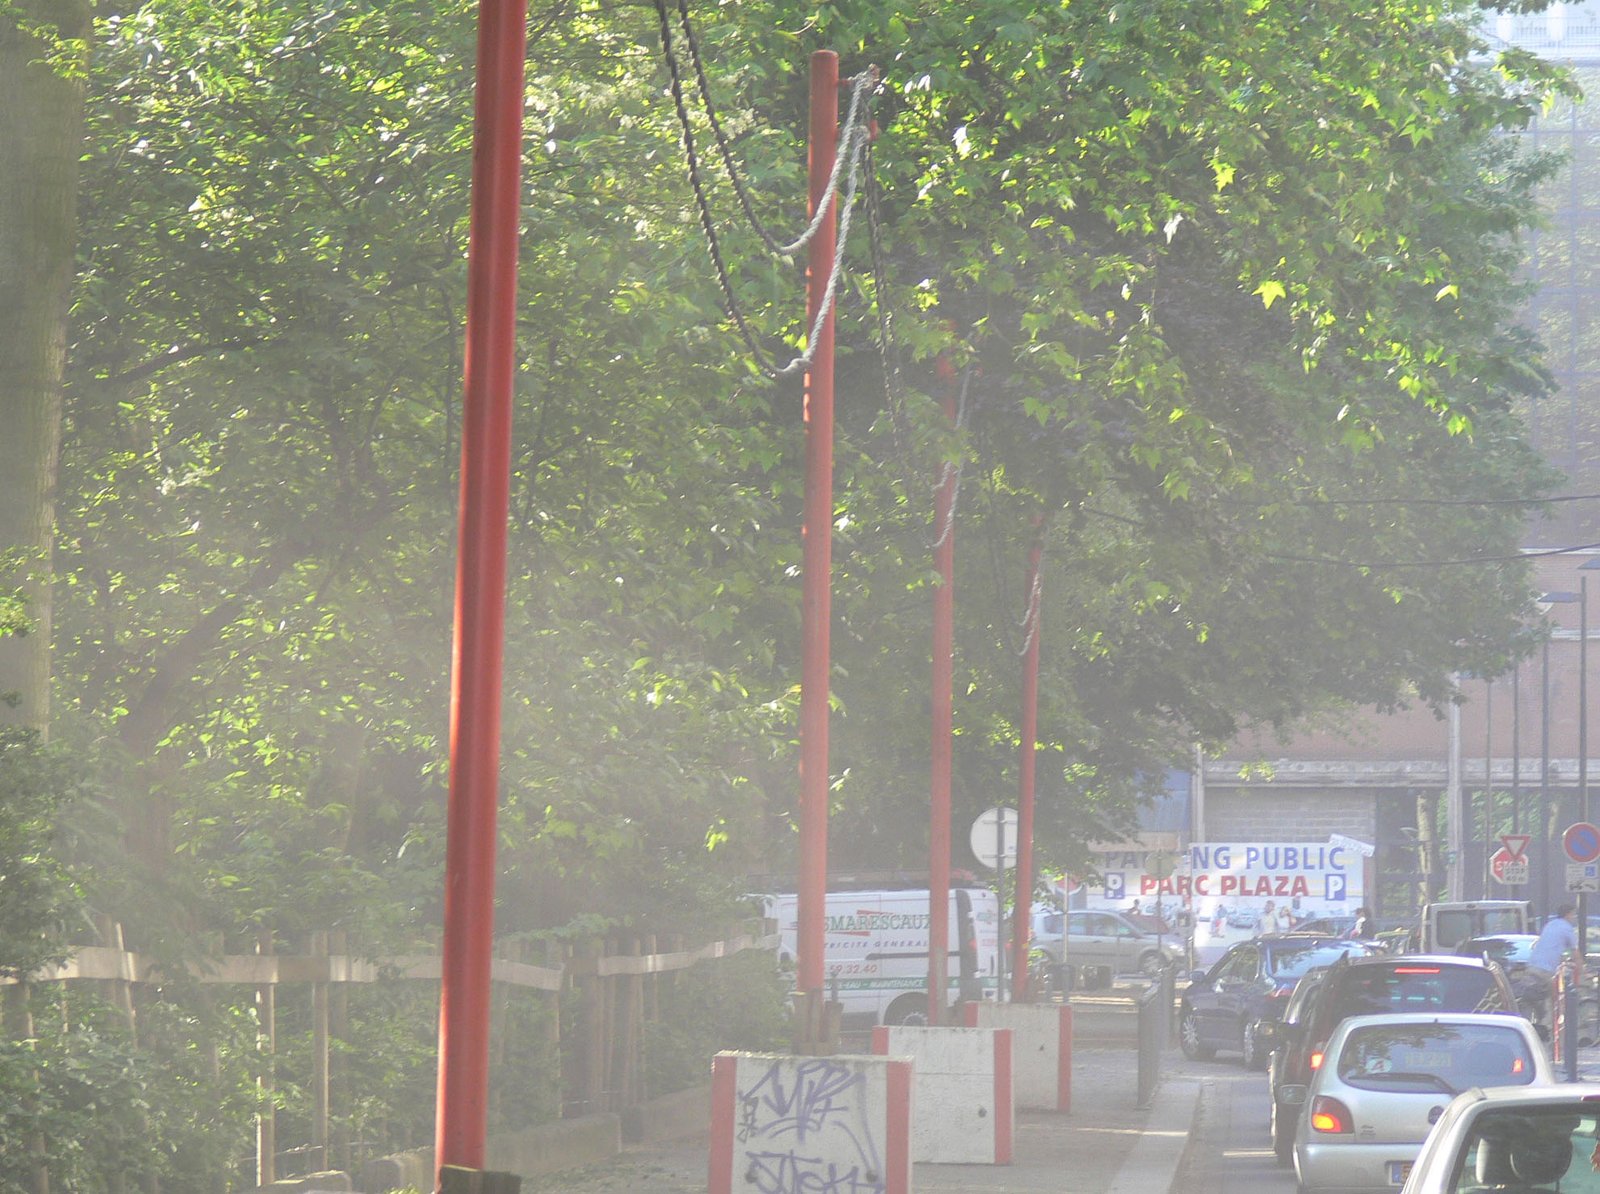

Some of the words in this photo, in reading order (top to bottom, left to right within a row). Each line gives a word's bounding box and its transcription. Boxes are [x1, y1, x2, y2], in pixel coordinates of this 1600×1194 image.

[1105, 846, 1231, 870] PANG
[1245, 846, 1345, 870] PUBLIC
[1140, 874, 1209, 896] PARC
[1220, 875, 1309, 896] PLAZA
[1327, 875, 1344, 899] P
